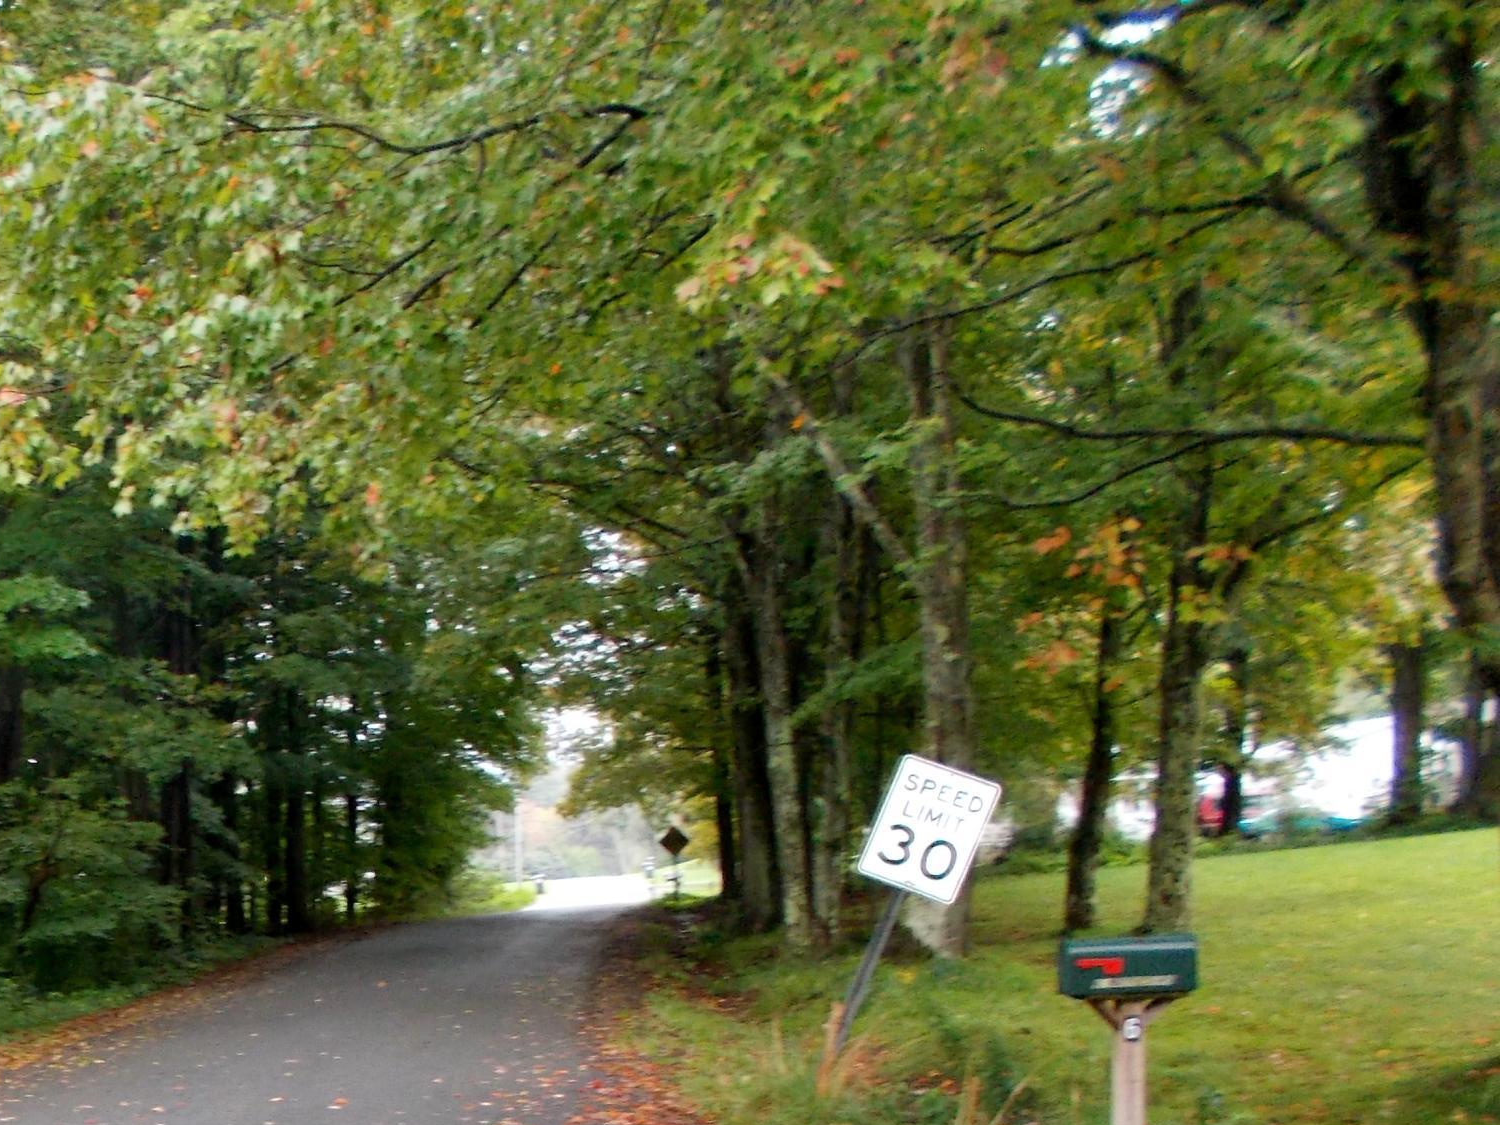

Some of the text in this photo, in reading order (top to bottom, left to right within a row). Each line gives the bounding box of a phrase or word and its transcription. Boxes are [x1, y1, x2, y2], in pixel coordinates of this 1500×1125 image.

[904, 773, 984, 813] SPEED
[902, 800, 965, 832] LIMIT
[877, 824, 958, 881] 30
